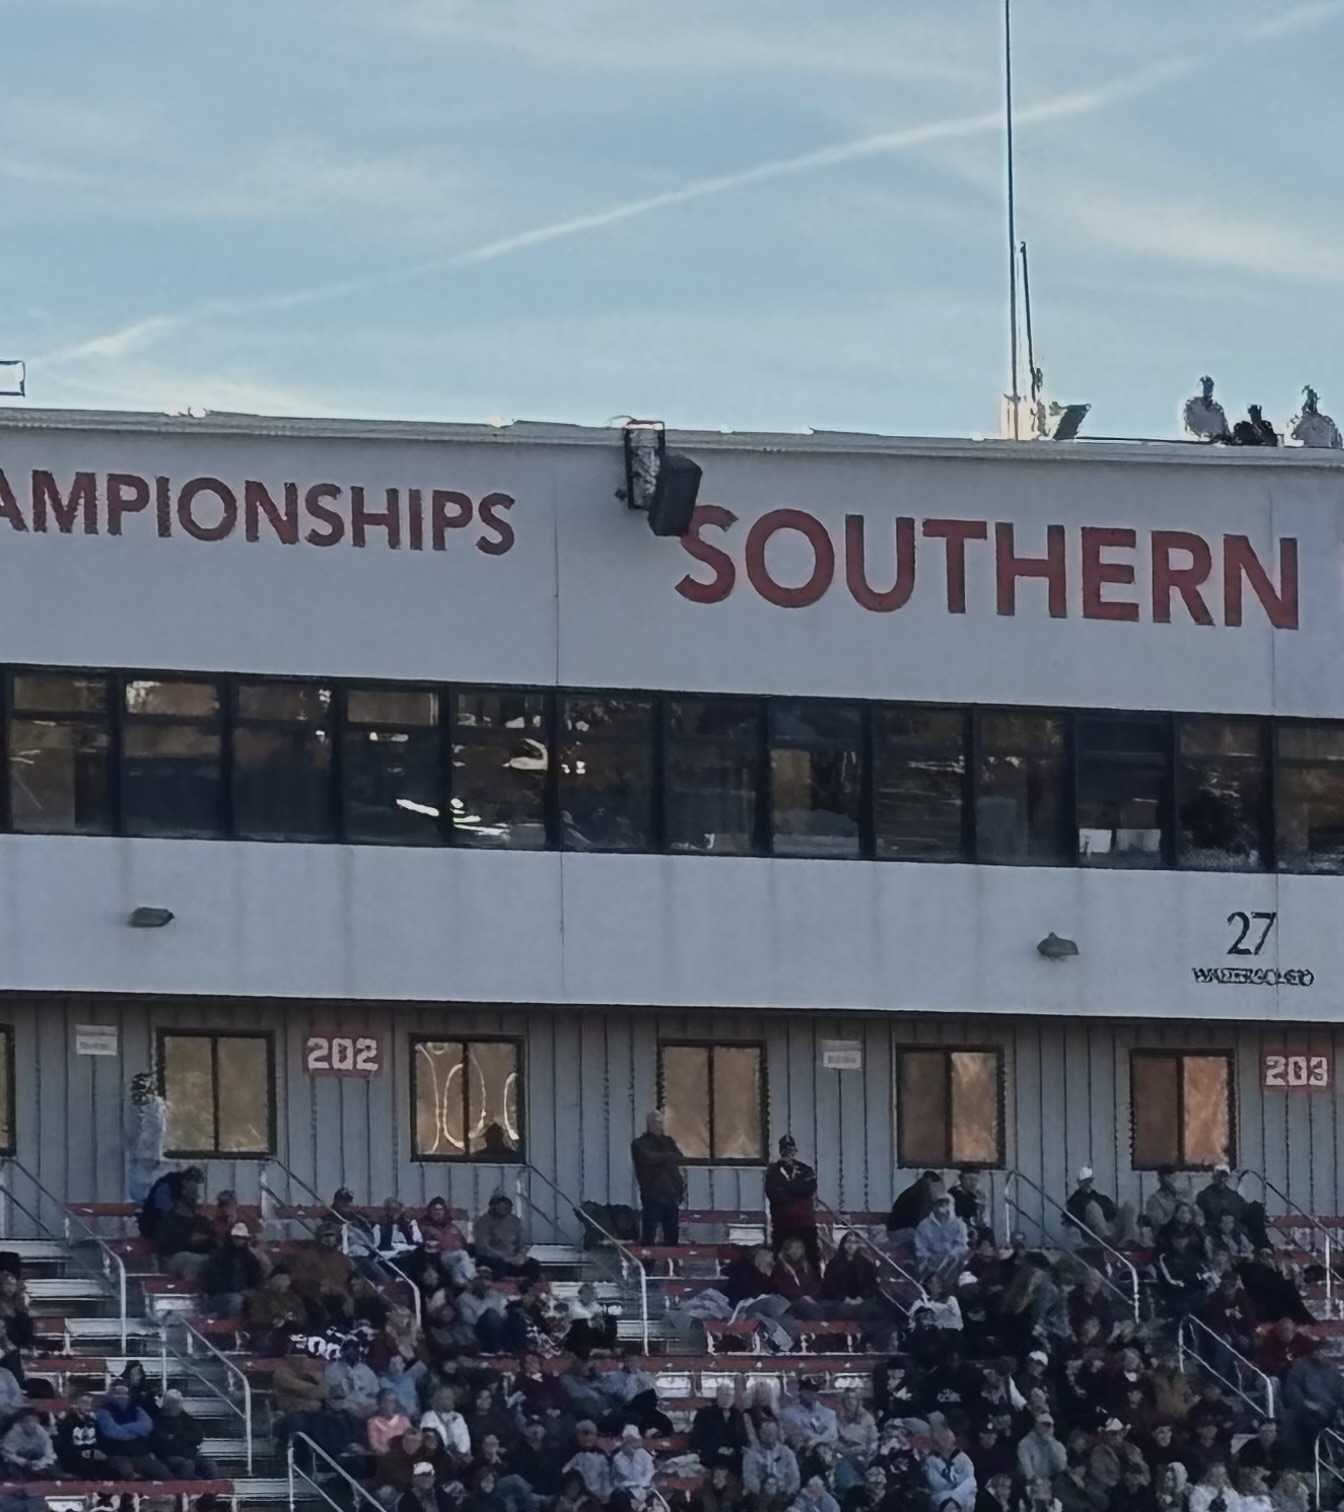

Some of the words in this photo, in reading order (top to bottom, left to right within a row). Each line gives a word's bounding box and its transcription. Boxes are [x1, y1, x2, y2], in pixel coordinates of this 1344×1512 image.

[674, 503, 1299, 630] SOUTHERN
[1226, 911, 1278, 956] 27
[307, 1037, 379, 1071] 202
[1266, 1056, 1328, 1086] 203
